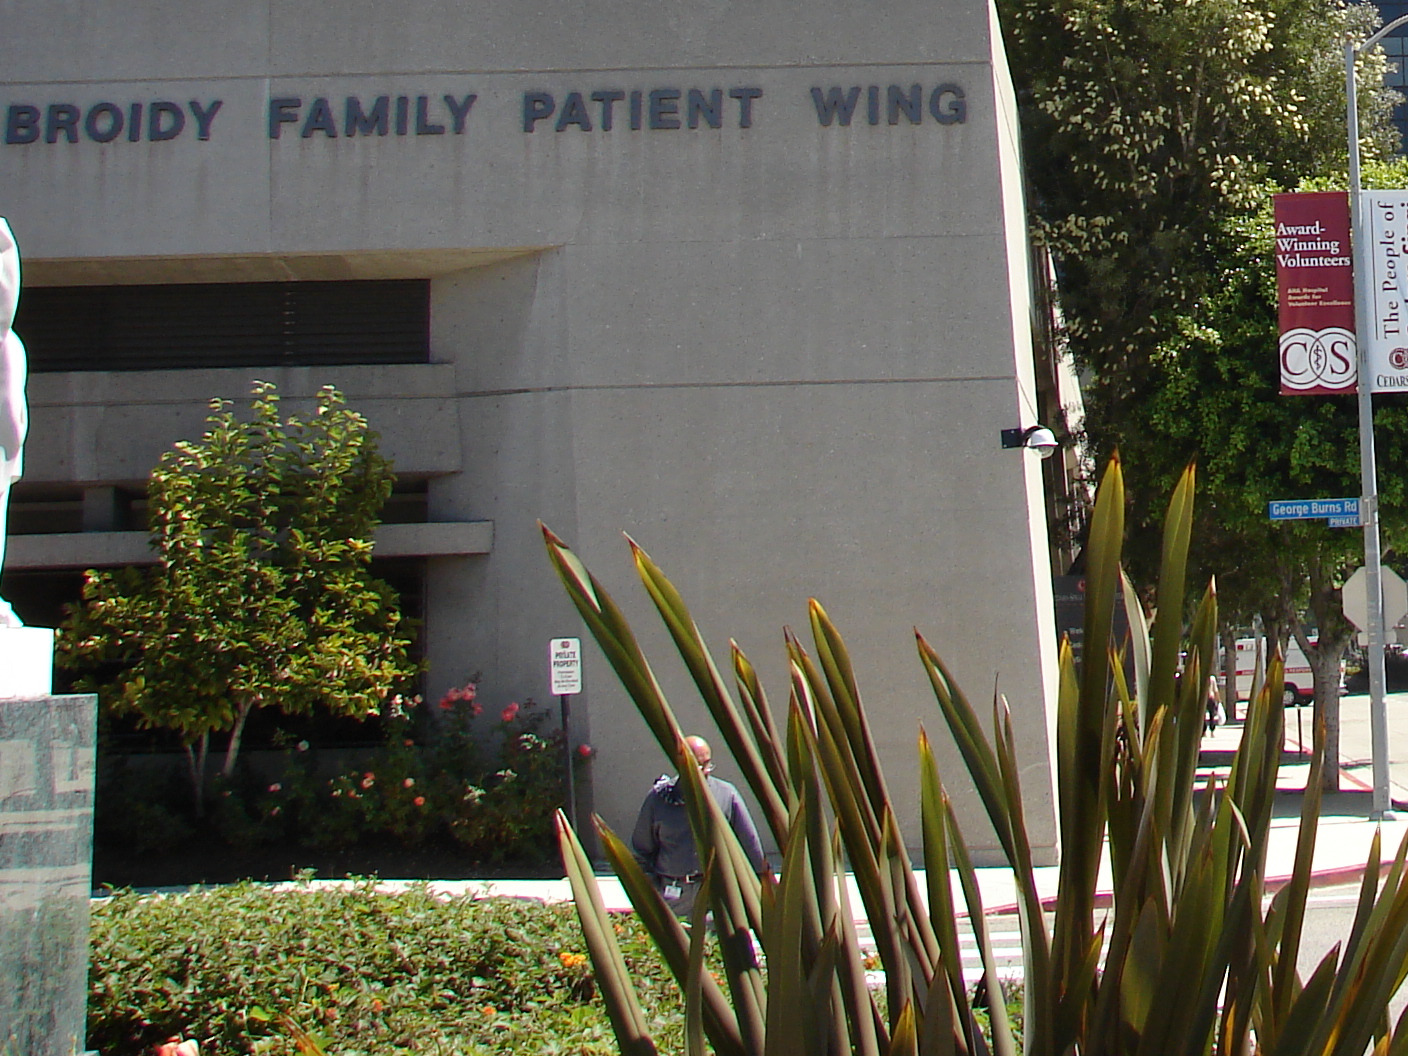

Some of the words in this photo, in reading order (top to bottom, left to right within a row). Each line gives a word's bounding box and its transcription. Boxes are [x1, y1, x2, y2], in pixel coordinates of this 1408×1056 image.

[6, 99, 225, 144] BROIDY
[268, 94, 479, 140] FAMILY
[522, 87, 764, 133] PATIENT
[810, 82, 970, 128] WING
[1377, 201, 1395, 221] of
[1277, 220, 1327, 236] Award-
[1277, 237, 1340, 256] Winning
[1277, 253, 1351, 268] Volunteers
[1379, 229, 1400, 291] People
[1383, 301, 1401, 340] The
[1273, 503, 1309, 517] George
[1311, 502, 1342, 513] Burns
[1344, 501, 1357, 512] Rd
[1330, 517, 1358, 525] PRIVATE
